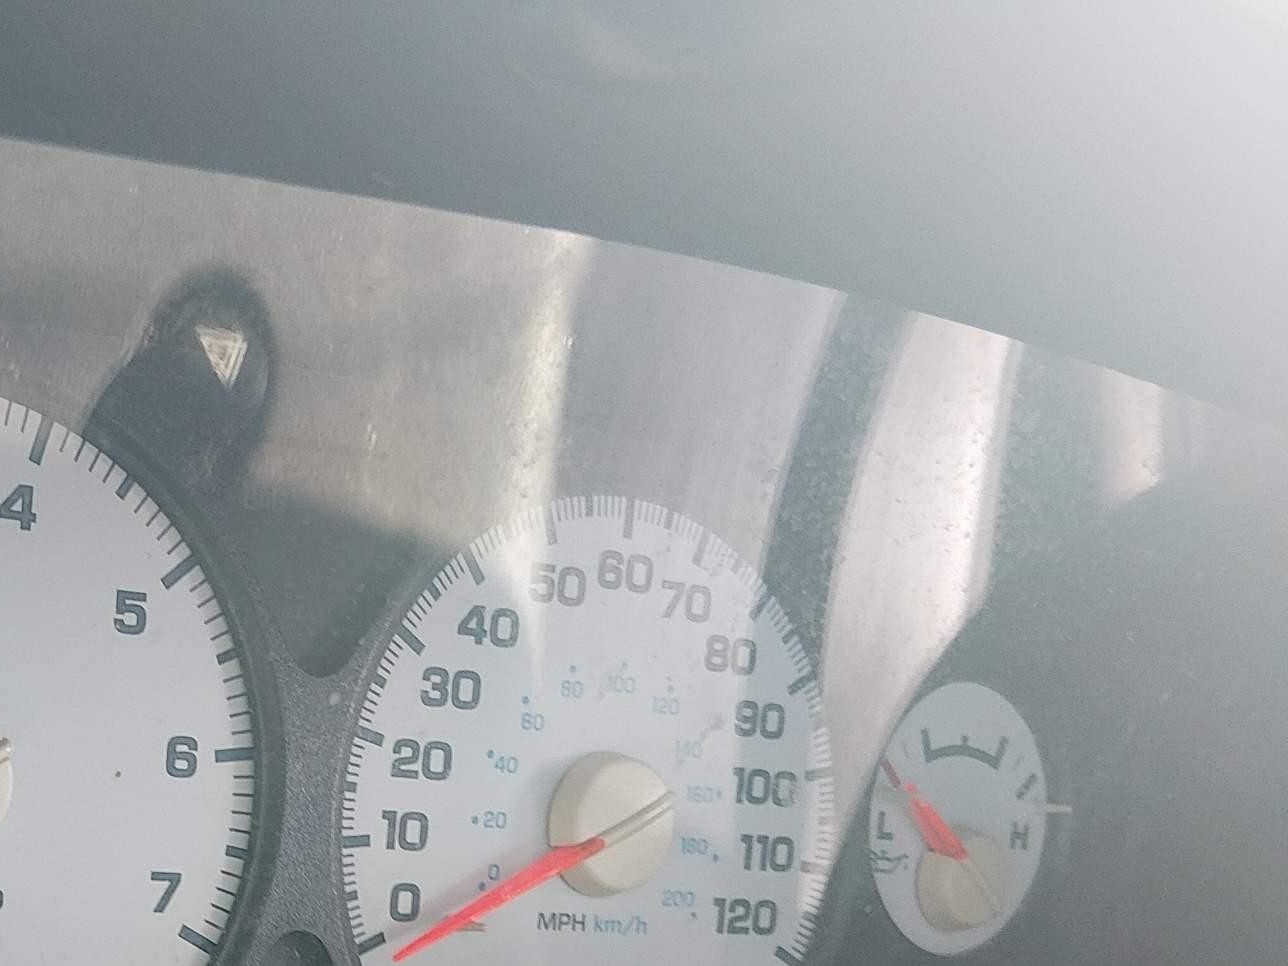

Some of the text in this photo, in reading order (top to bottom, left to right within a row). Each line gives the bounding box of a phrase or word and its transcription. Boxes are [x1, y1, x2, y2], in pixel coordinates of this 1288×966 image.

[528, 562, 586, 606] 50
[597, 549, 654, 593] 60
[113, 589, 147, 634] 5
[660, 579, 712, 623] 70
[457, 604, 520, 648] 40
[703, 634, 757, 675] 80
[420, 667, 481, 710] 30
[520, 712, 544, 731] 60
[734, 700, 785, 739] 90
[165, 736, 199, 777] 6
[390, 739, 452, 781] 20
[494, 756, 519, 774] 40
[733, 767, 797, 808] 100
[381, 811, 429, 851] 10
[483, 811, 507, 829] 20
[876, 811, 894, 841] L
[1010, 821, 1030, 850] H
[740, 834, 795, 873] 110
[150, 872, 182, 914] 7
[389, 882, 421, 922] 0
[536, 912, 648, 935] MPH km/h
[713, 897, 777, 936] 120
